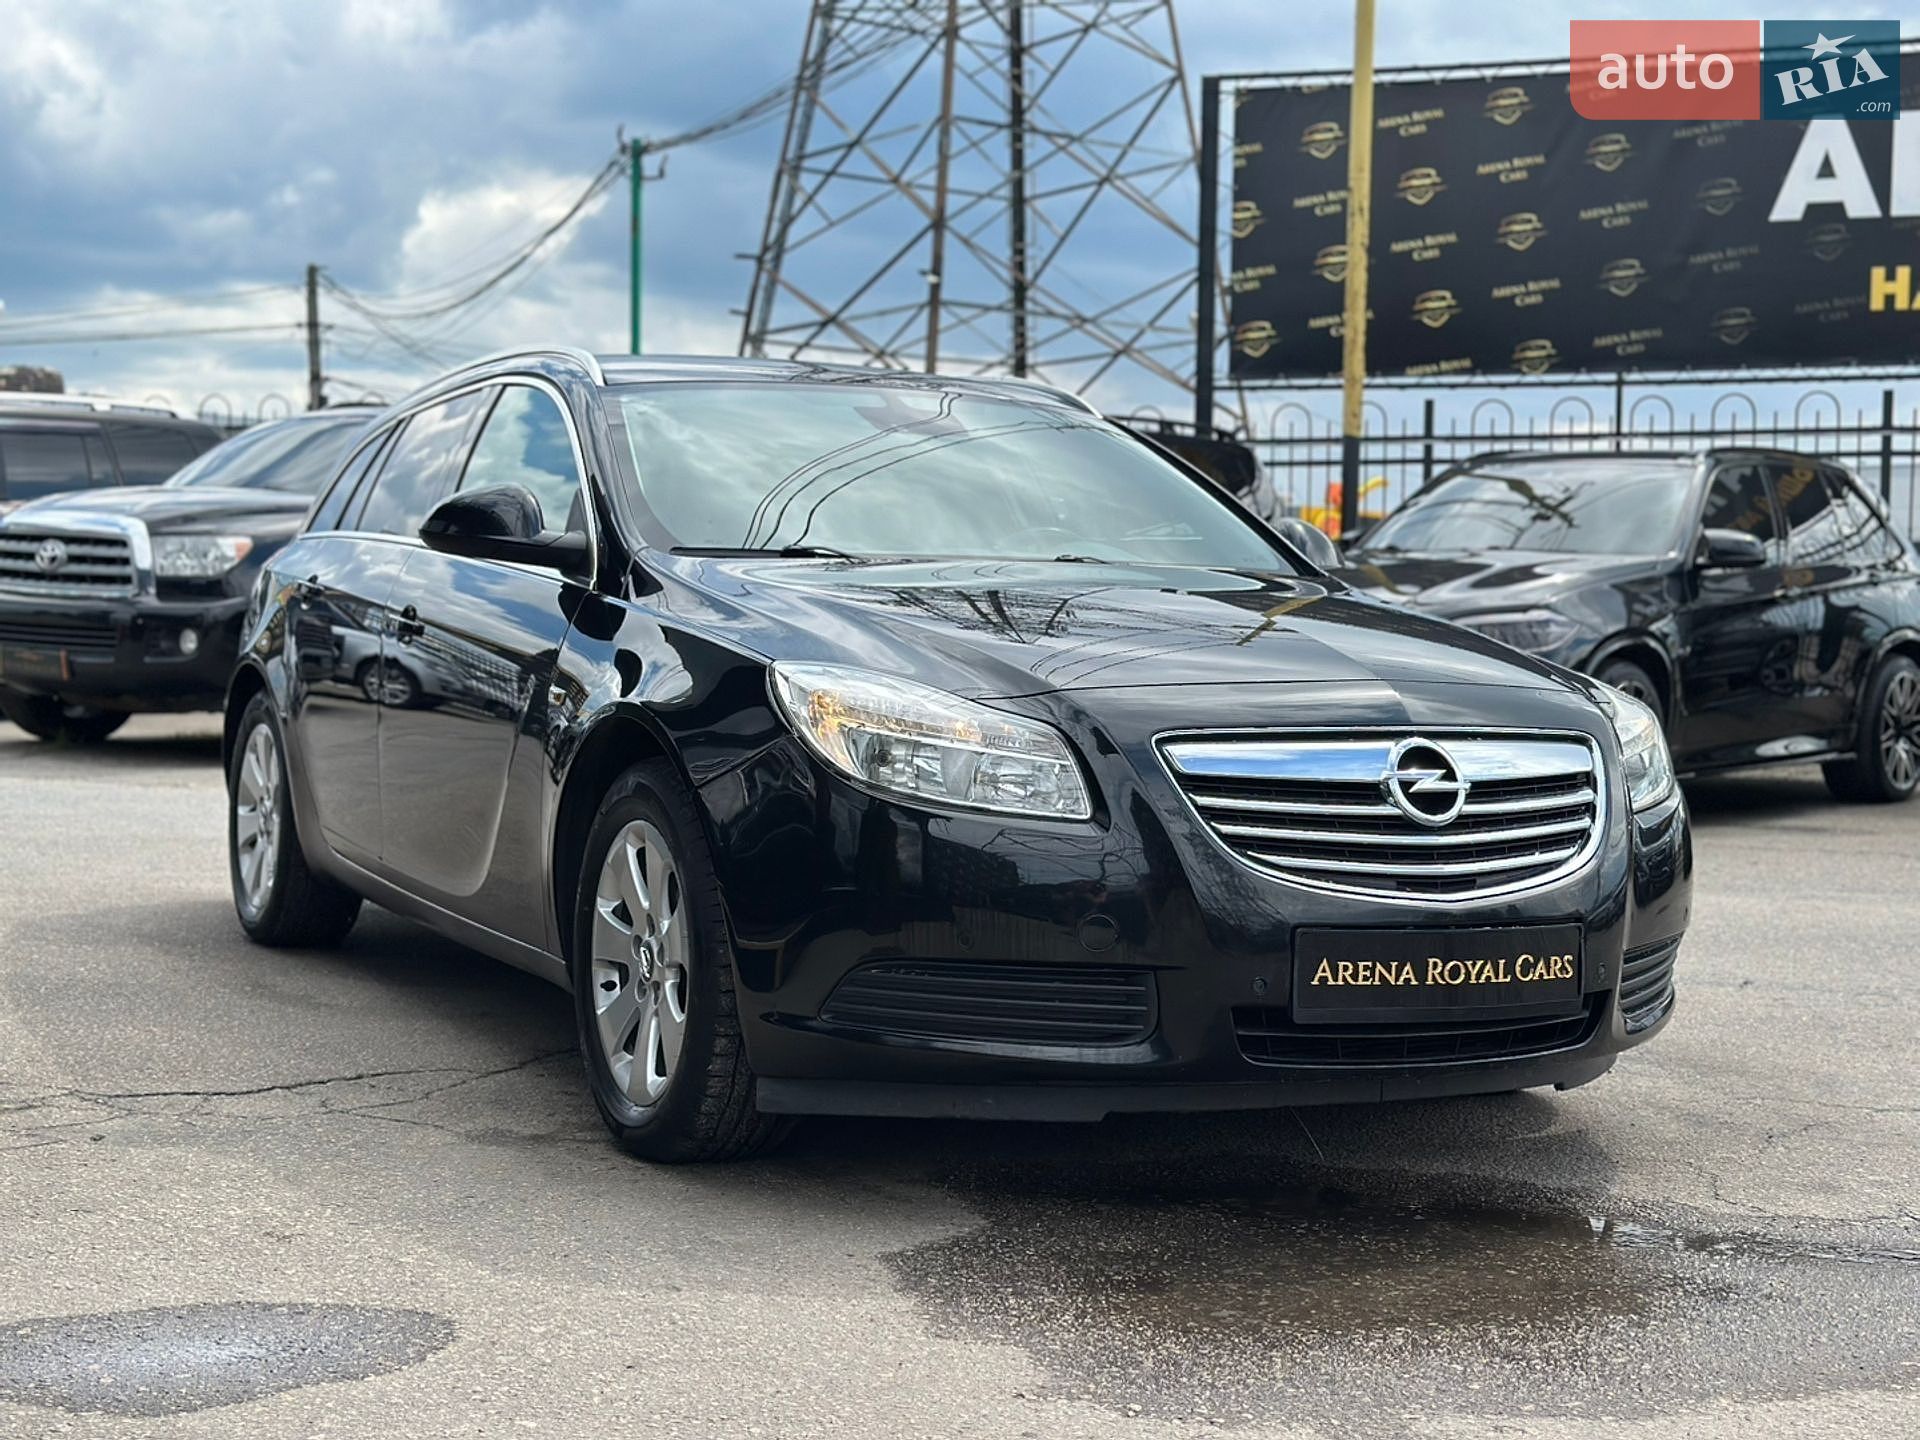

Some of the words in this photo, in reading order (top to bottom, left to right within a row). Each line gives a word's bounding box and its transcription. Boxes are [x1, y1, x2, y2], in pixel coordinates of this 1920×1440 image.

[1311, 958, 1419, 986] ARENA
[1425, 957, 1511, 985] ROYAL
[1515, 953, 1574, 982] CARS
